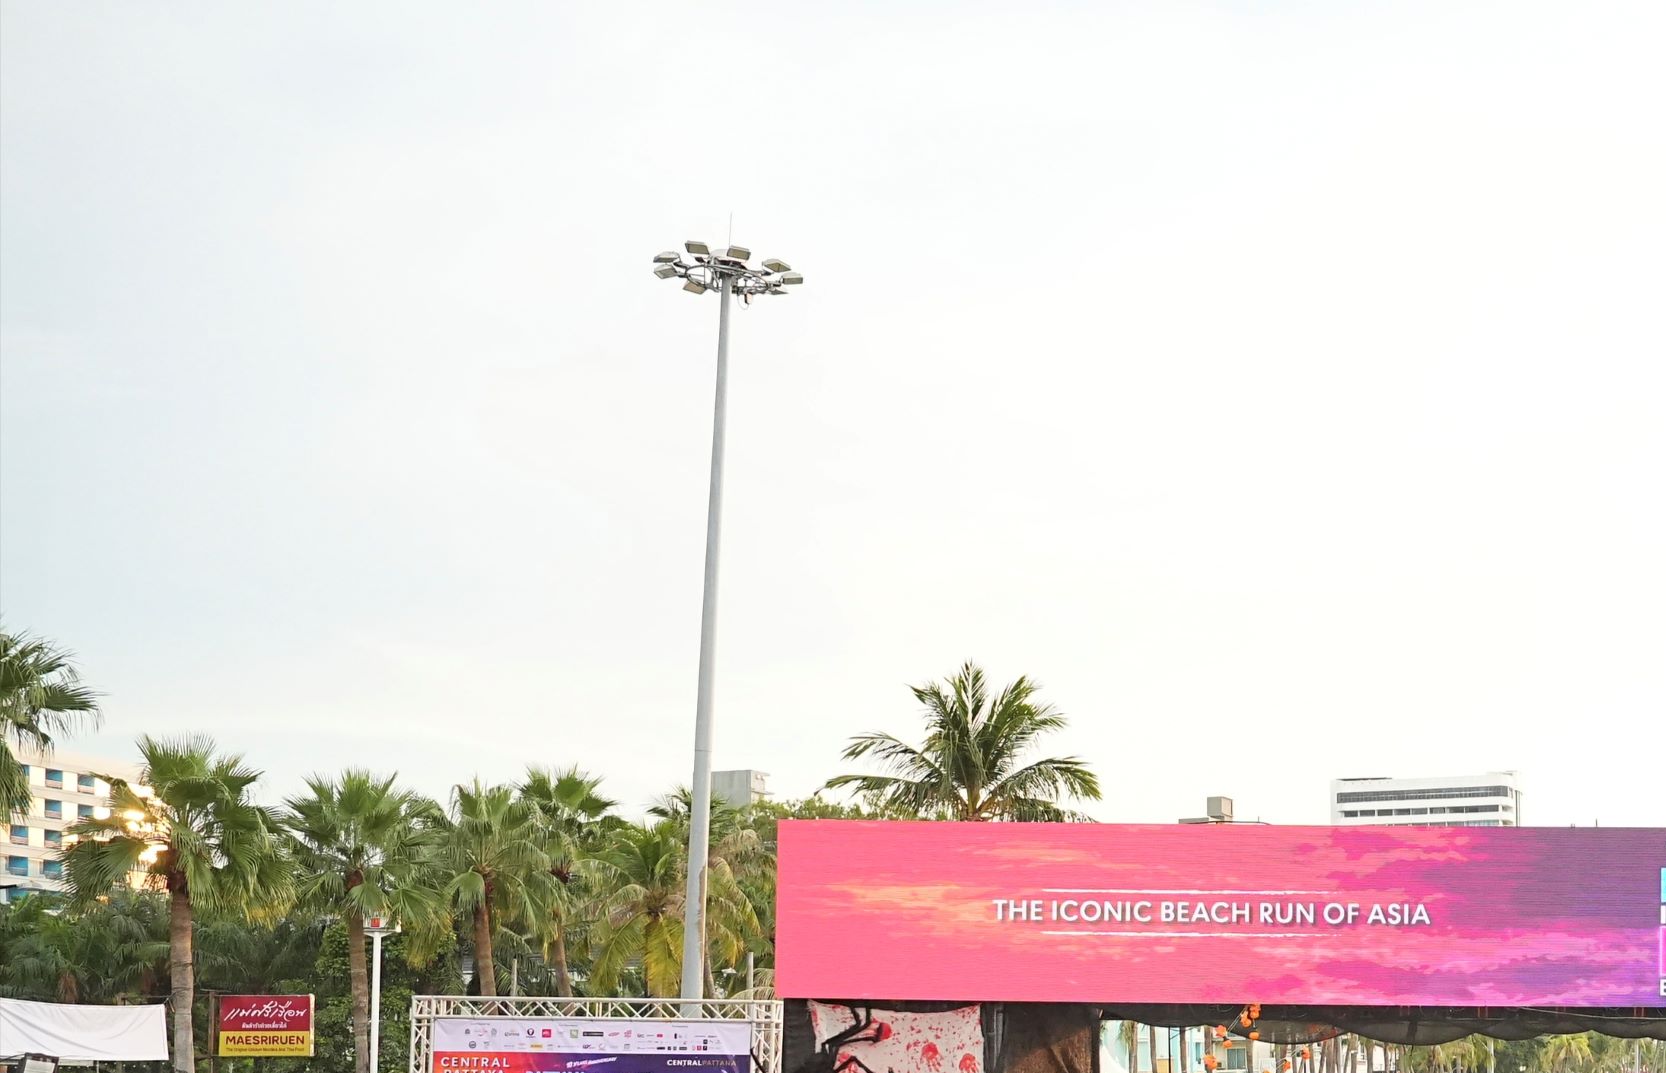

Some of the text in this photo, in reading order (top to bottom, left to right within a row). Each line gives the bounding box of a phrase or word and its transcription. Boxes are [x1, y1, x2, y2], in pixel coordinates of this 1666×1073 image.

[993, 898, 1431, 925] THE ICONIC BEACH RUN OF ASIA
[225, 1035, 305, 1045] MAESRIRUEN
[440, 1056, 510, 1068] CENTRAL
